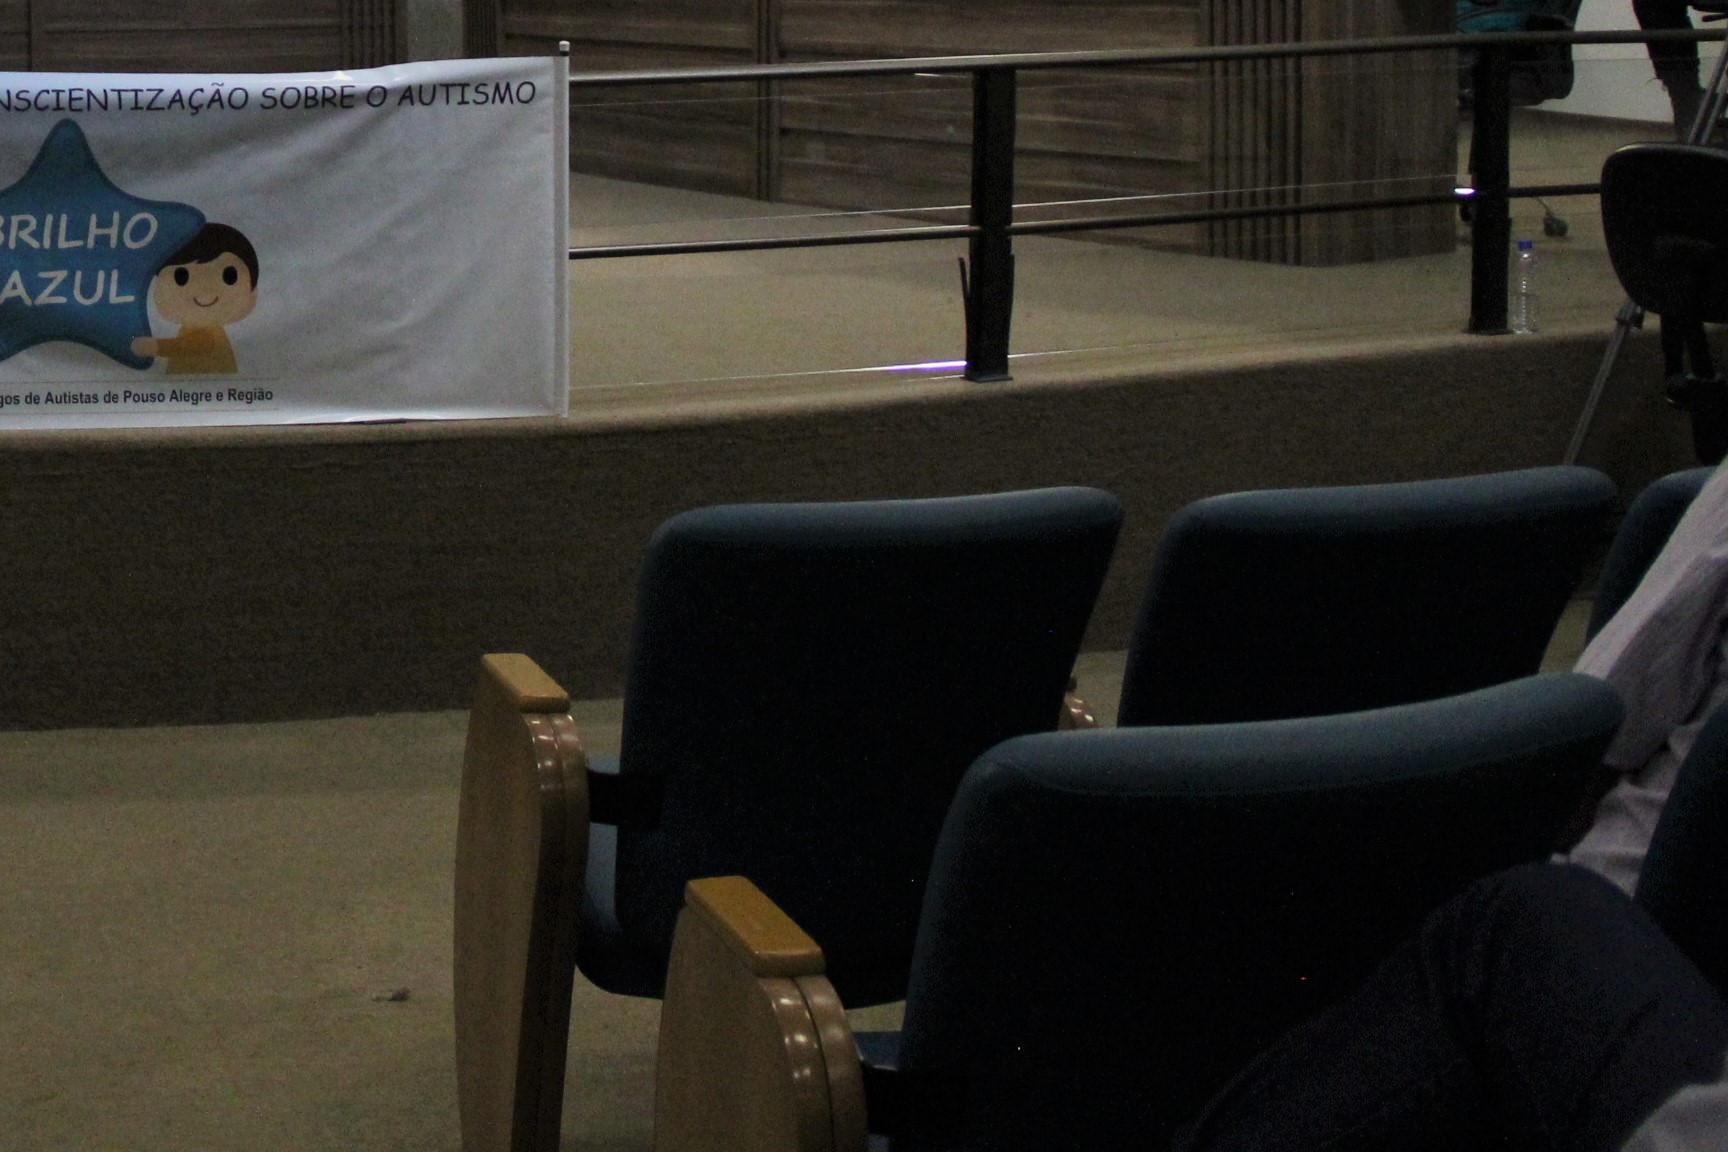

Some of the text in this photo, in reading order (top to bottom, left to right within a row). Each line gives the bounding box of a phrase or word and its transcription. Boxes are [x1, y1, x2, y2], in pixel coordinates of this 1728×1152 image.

[260, 84, 356, 110] SOBRE
[366, 85, 388, 108] O
[397, 81, 536, 106] AUTISMO
[24, 392, 40, 405] de
[44, 391, 99, 405] Autistas
[103, 390, 119, 404] de
[124, 390, 166, 404] Pouso
[170, 389, 212, 406] Alegre
[216, 392, 224, 402] e
[228, 388, 273, 404] Região
